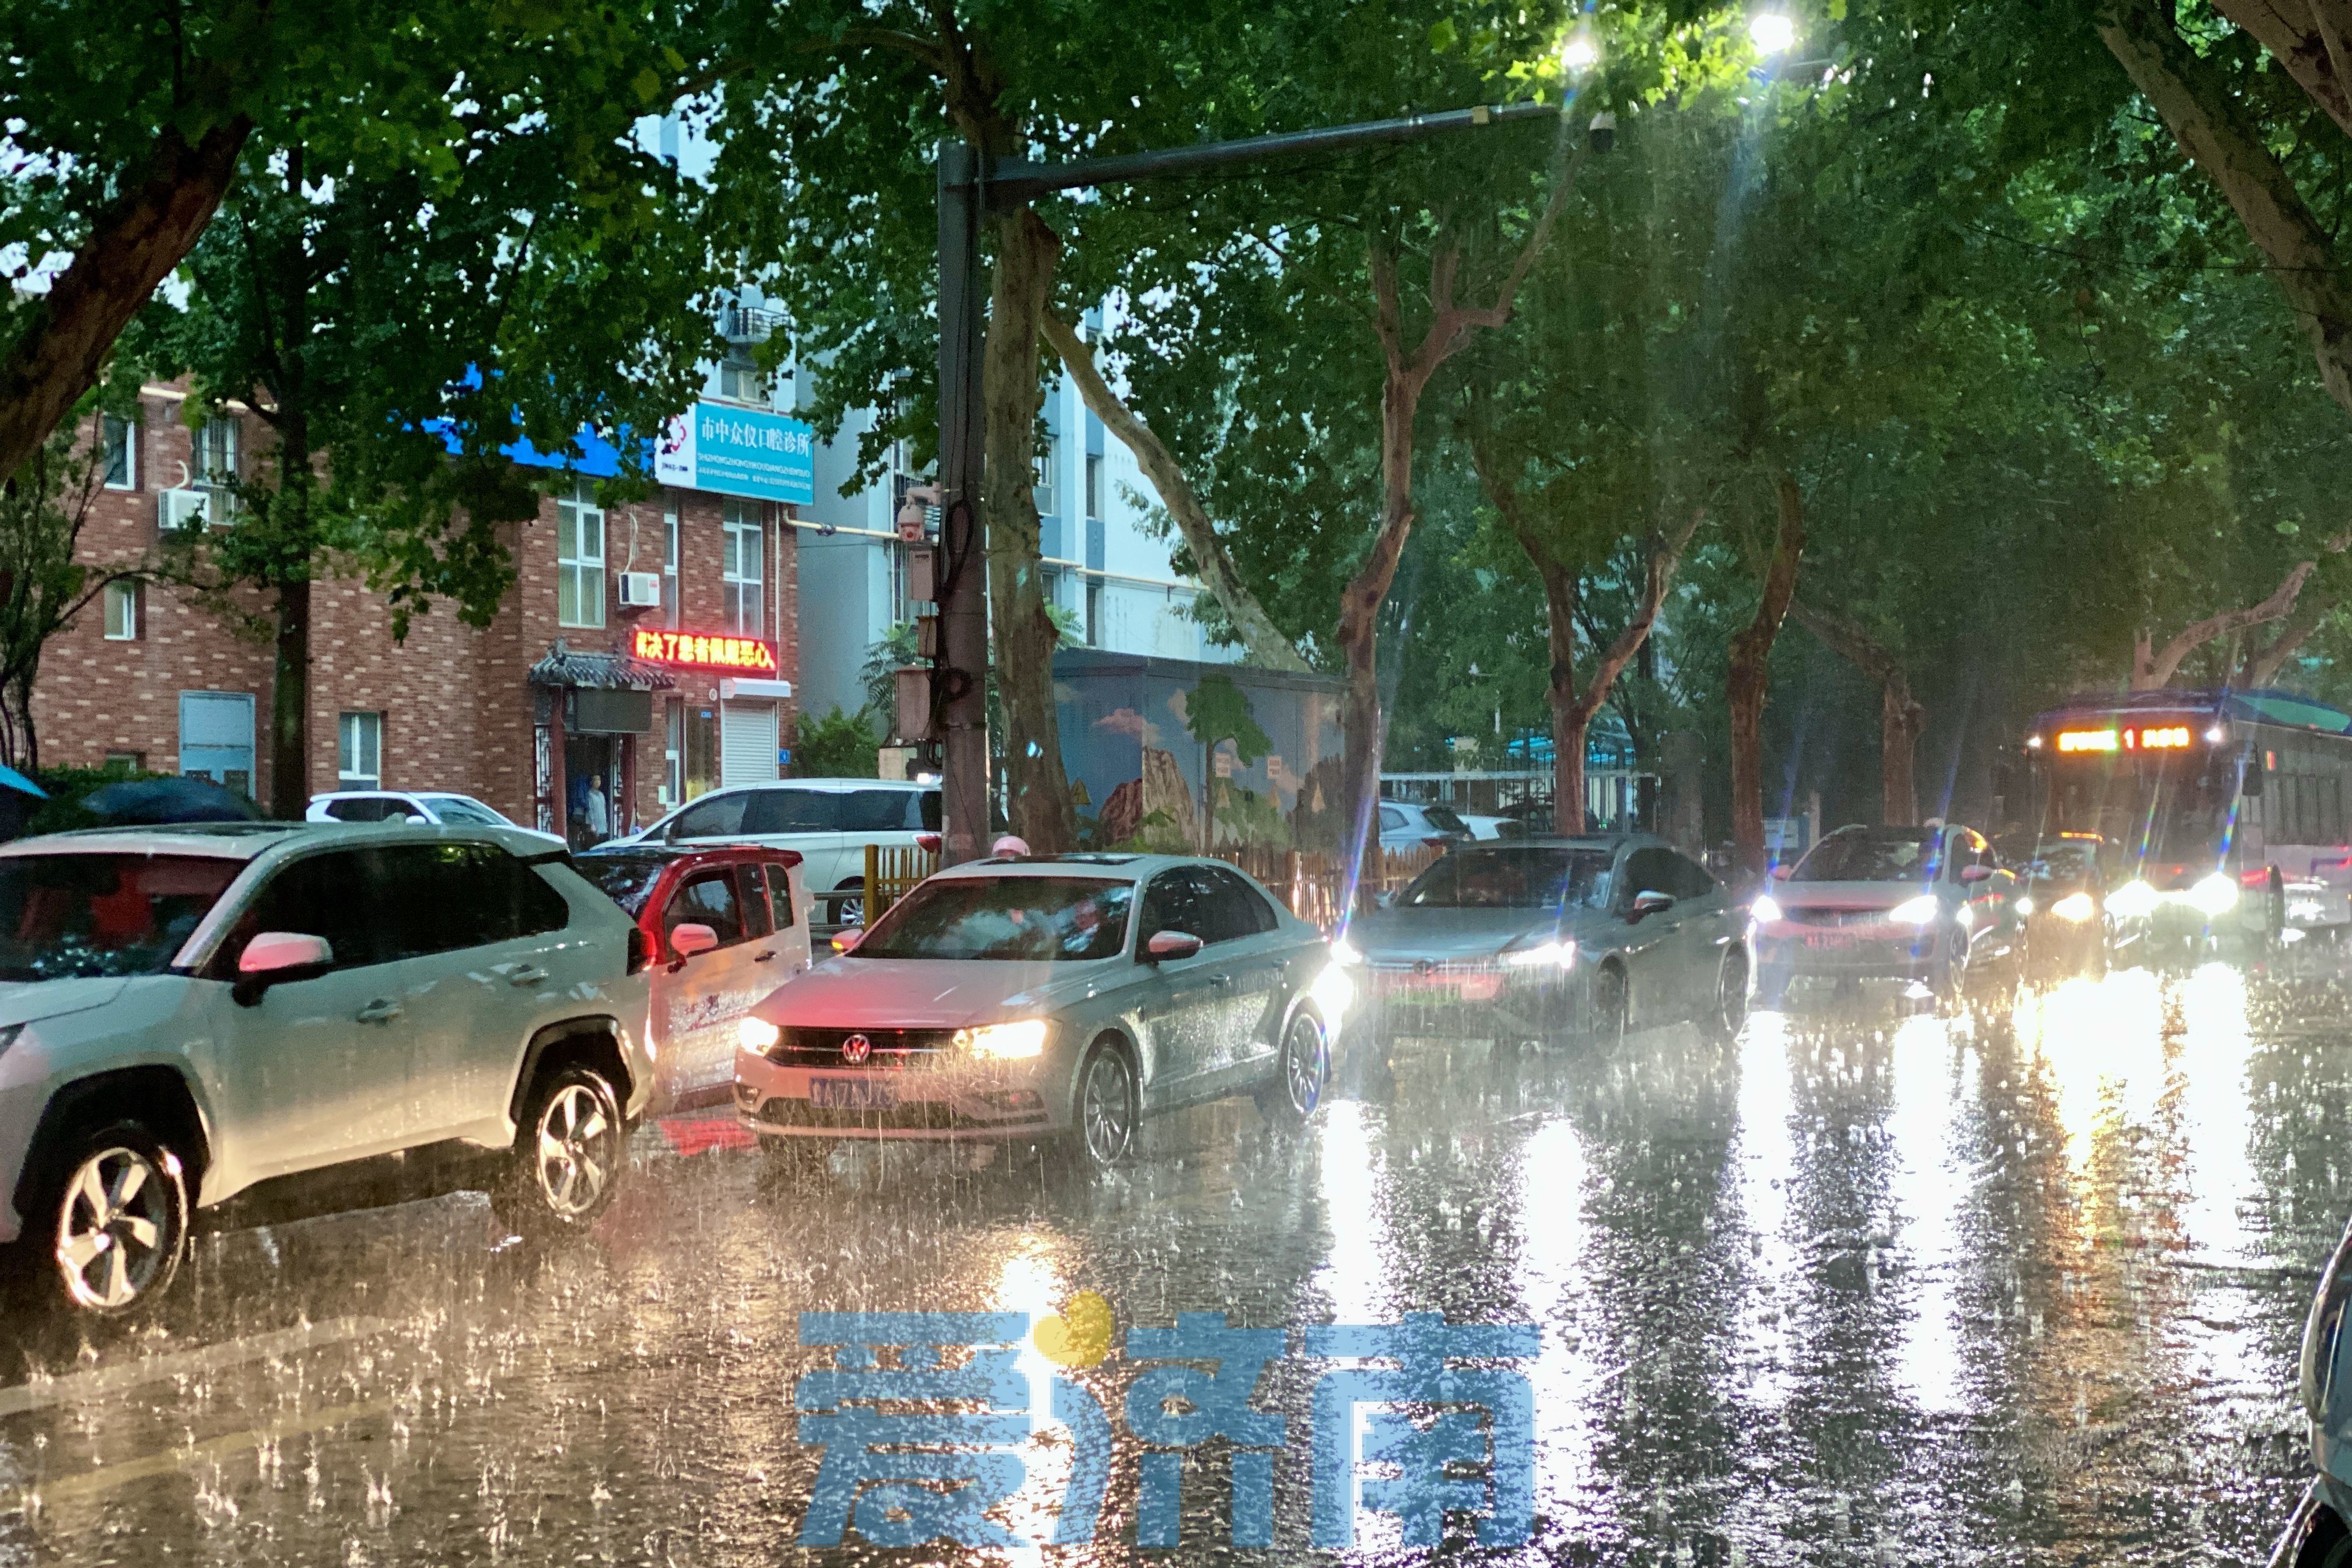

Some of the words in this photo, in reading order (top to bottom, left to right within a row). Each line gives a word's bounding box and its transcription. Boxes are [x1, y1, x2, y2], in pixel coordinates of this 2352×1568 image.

[702, 416, 809, 457] 市中众仪口腔诊所
